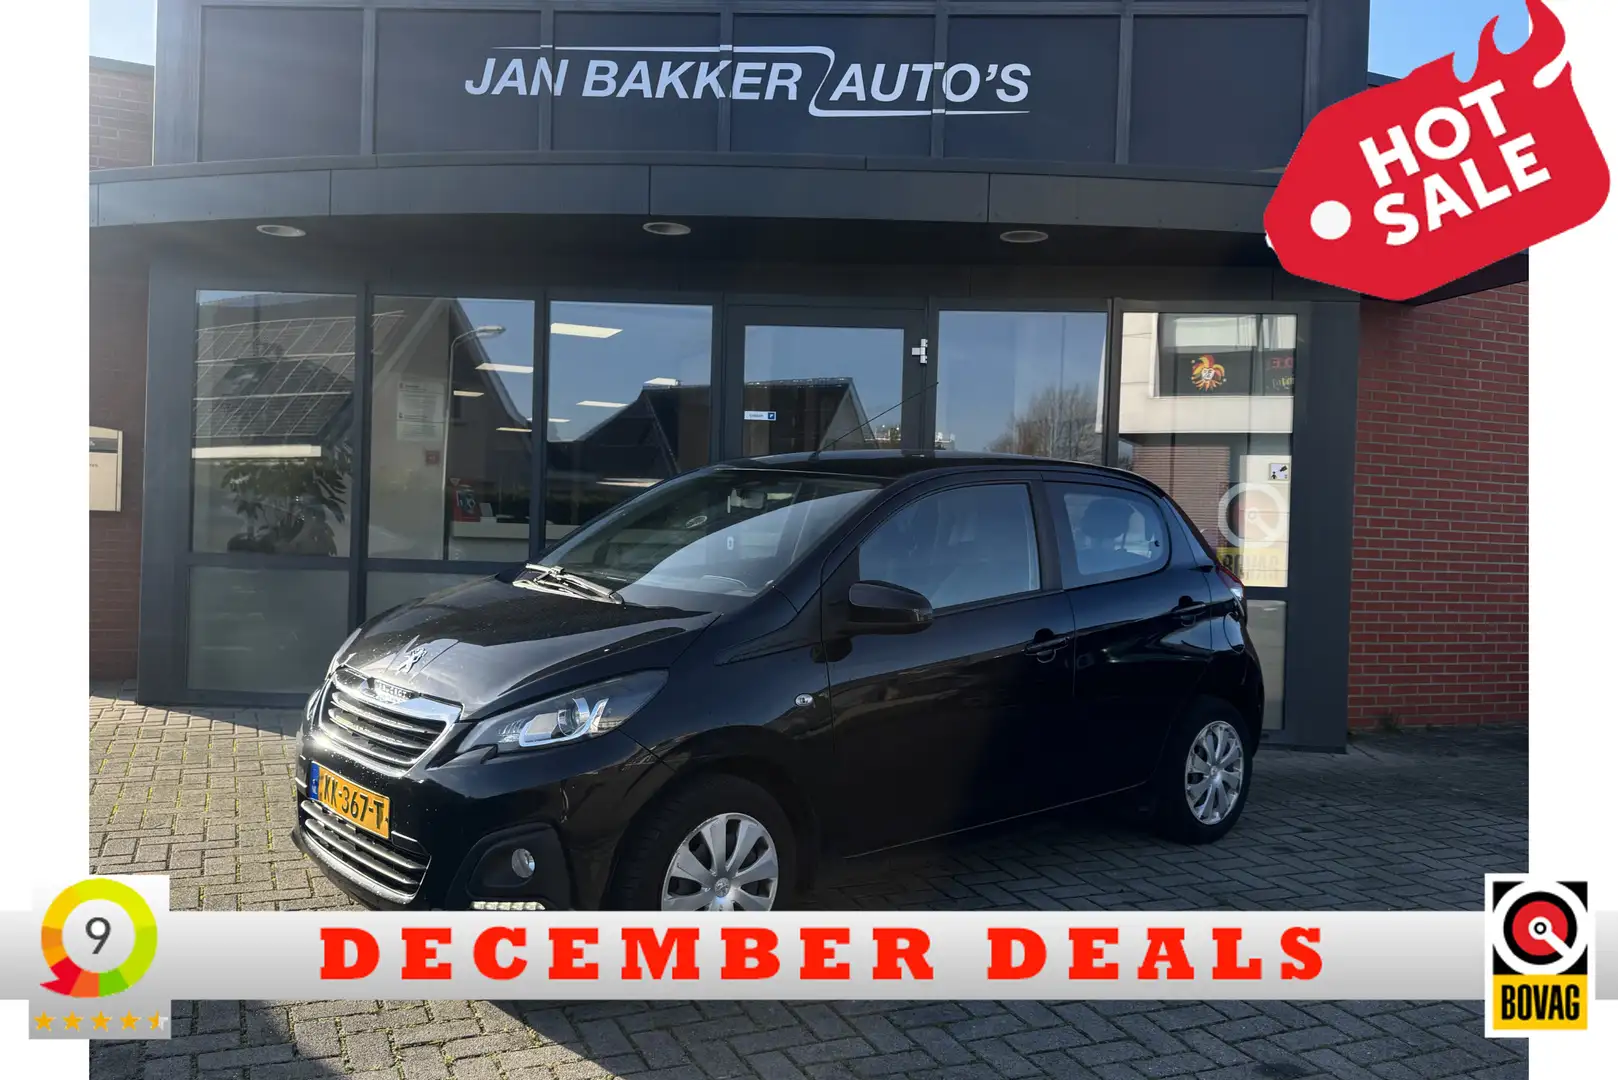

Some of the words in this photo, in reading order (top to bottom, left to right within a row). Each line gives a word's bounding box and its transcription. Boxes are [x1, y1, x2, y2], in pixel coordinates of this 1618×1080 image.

[465, 57, 569, 97] JAN
[581, 59, 802, 100] BAKKER
[831, 62, 1032, 103] AUTO'S
[324, 774, 385, 830] KK-367-T
